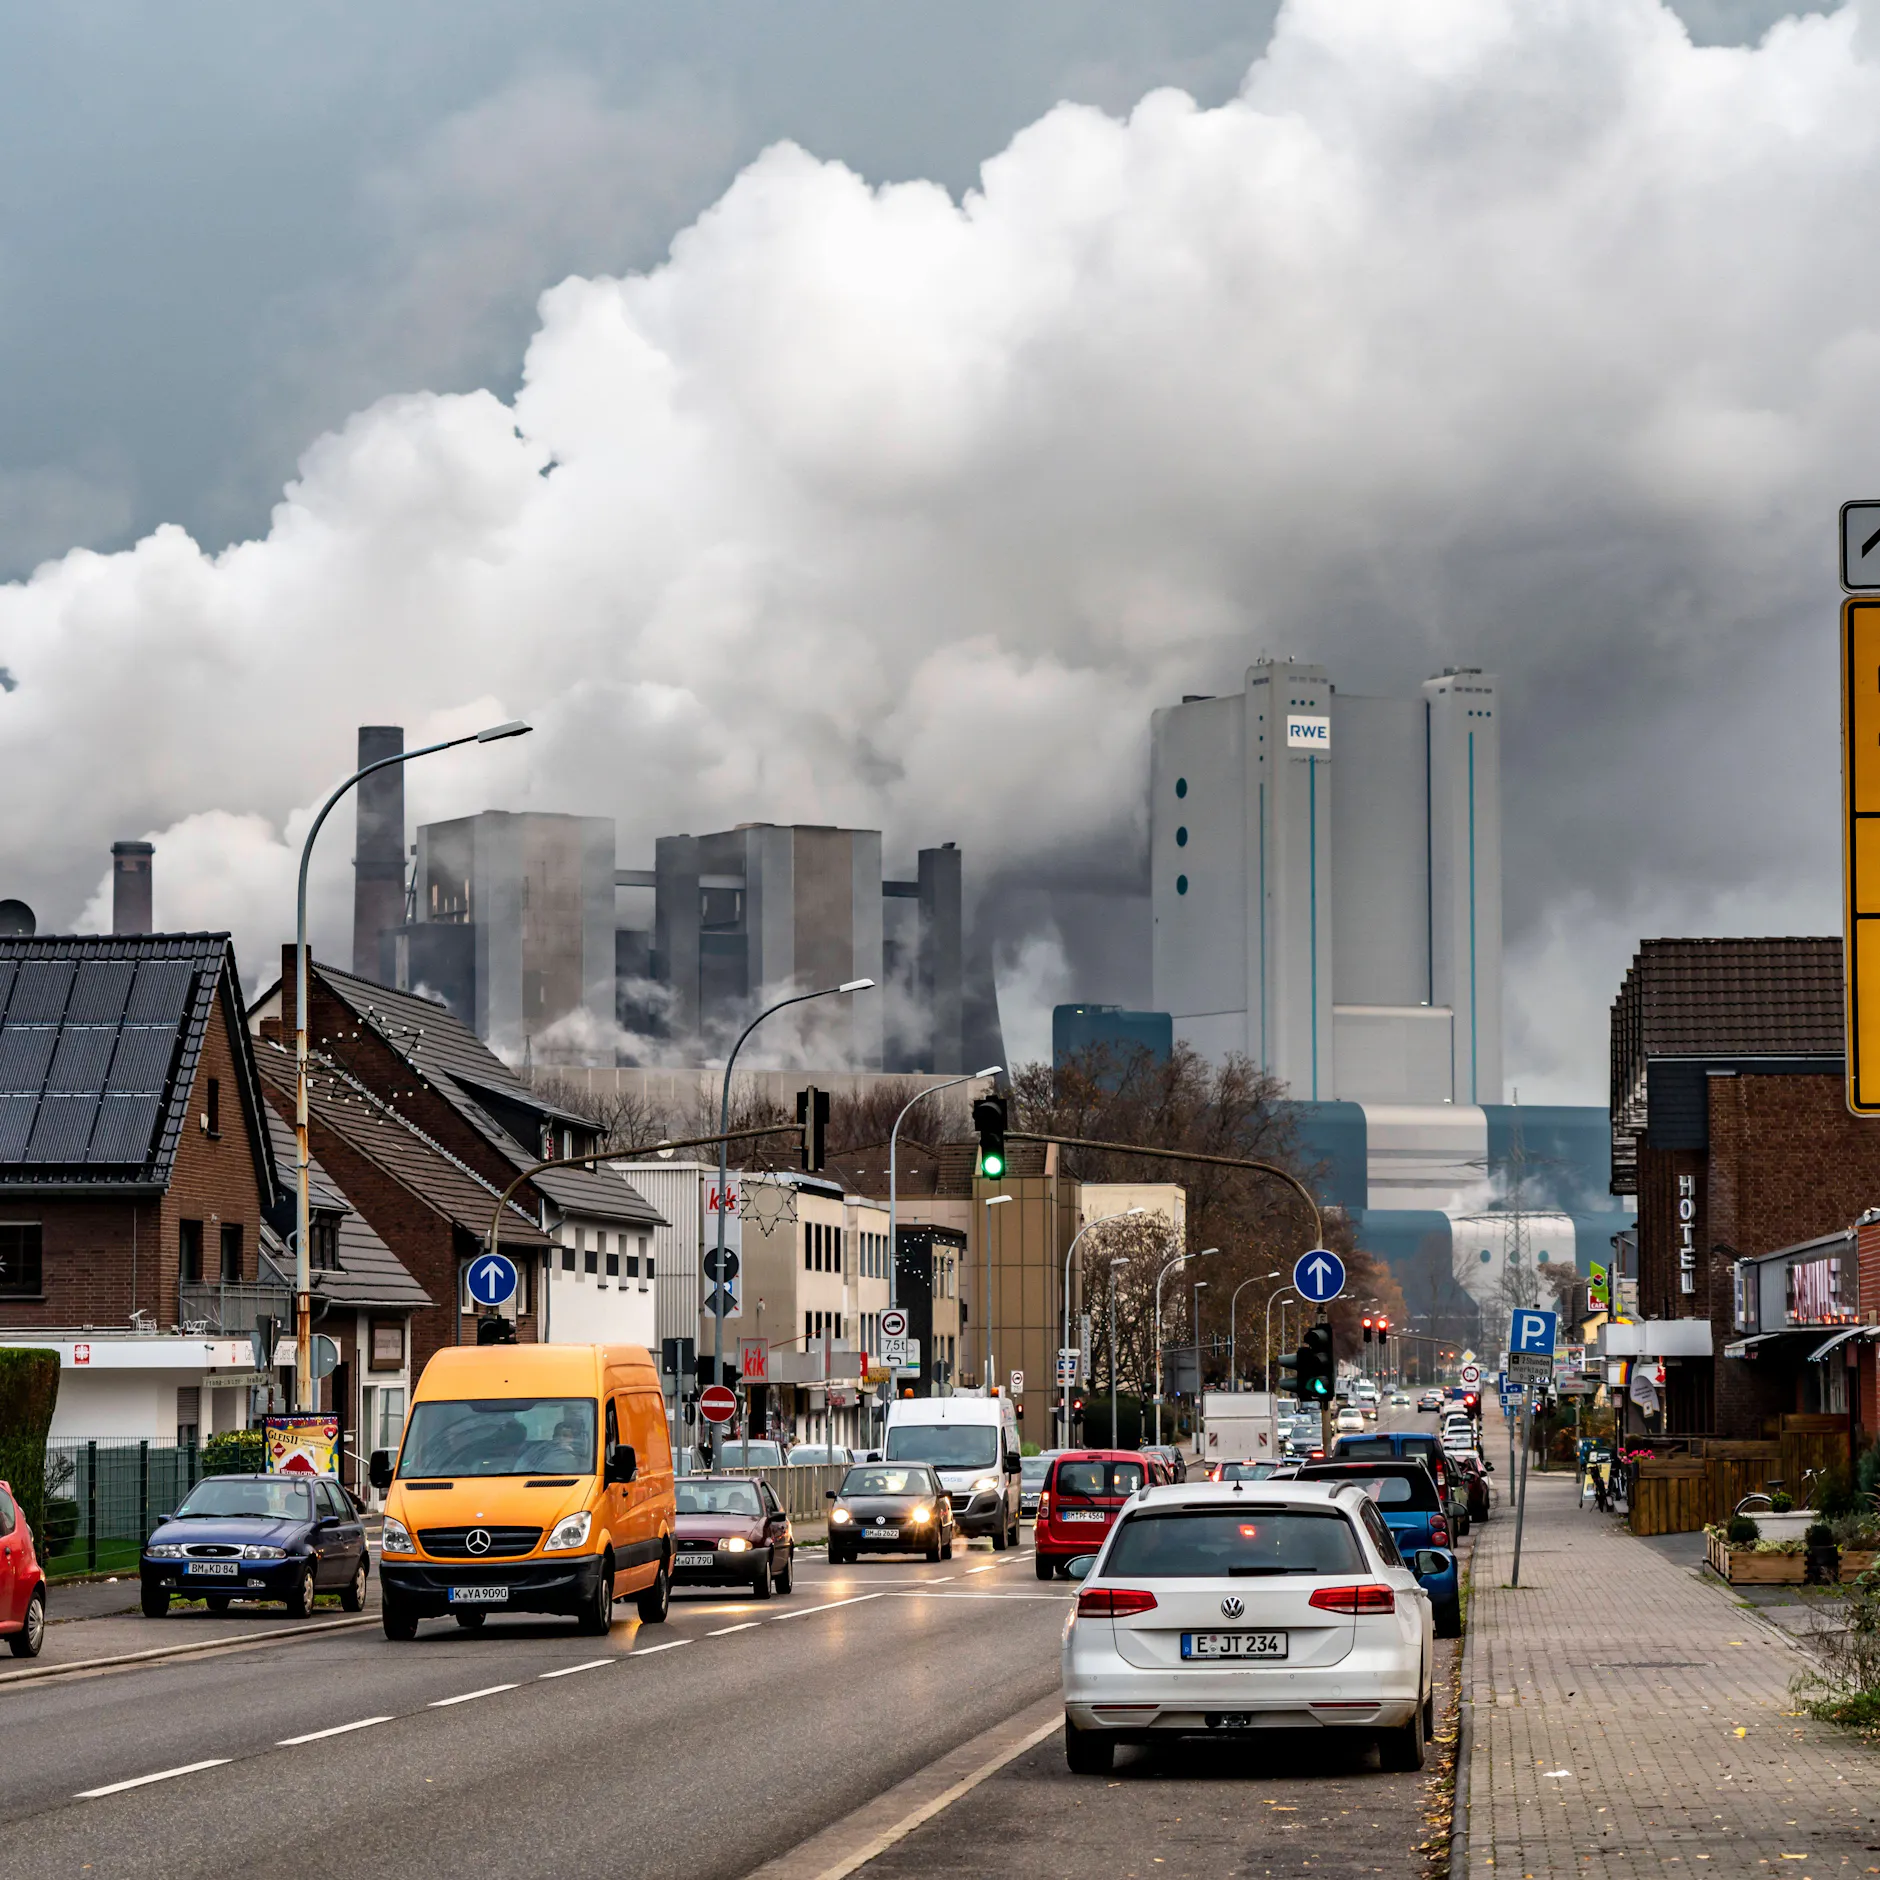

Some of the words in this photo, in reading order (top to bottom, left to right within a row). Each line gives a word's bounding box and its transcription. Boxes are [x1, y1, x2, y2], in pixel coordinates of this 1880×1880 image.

[1290, 724, 1327, 738] RWE
[709, 1183, 737, 1210] kk
[1679, 1175, 1696, 1294] HOTEL
[1521, 1315, 1546, 1349] P
[743, 1344, 766, 1377] kik
[191, 1563, 204, 1573] BM
[210, 1564, 221, 1574] KD
[223, 1564, 234, 1574] 84
[697, 1556, 712, 1565] 790
[455, 1589, 461, 1598] K
[468, 1588, 481, 1599] YA
[482, 1588, 507, 1598] 9090
[1197, 1636, 1208, 1653] E
[1220, 1636, 1242, 1653] JT
[1246, 1635, 1278, 1653] 234
